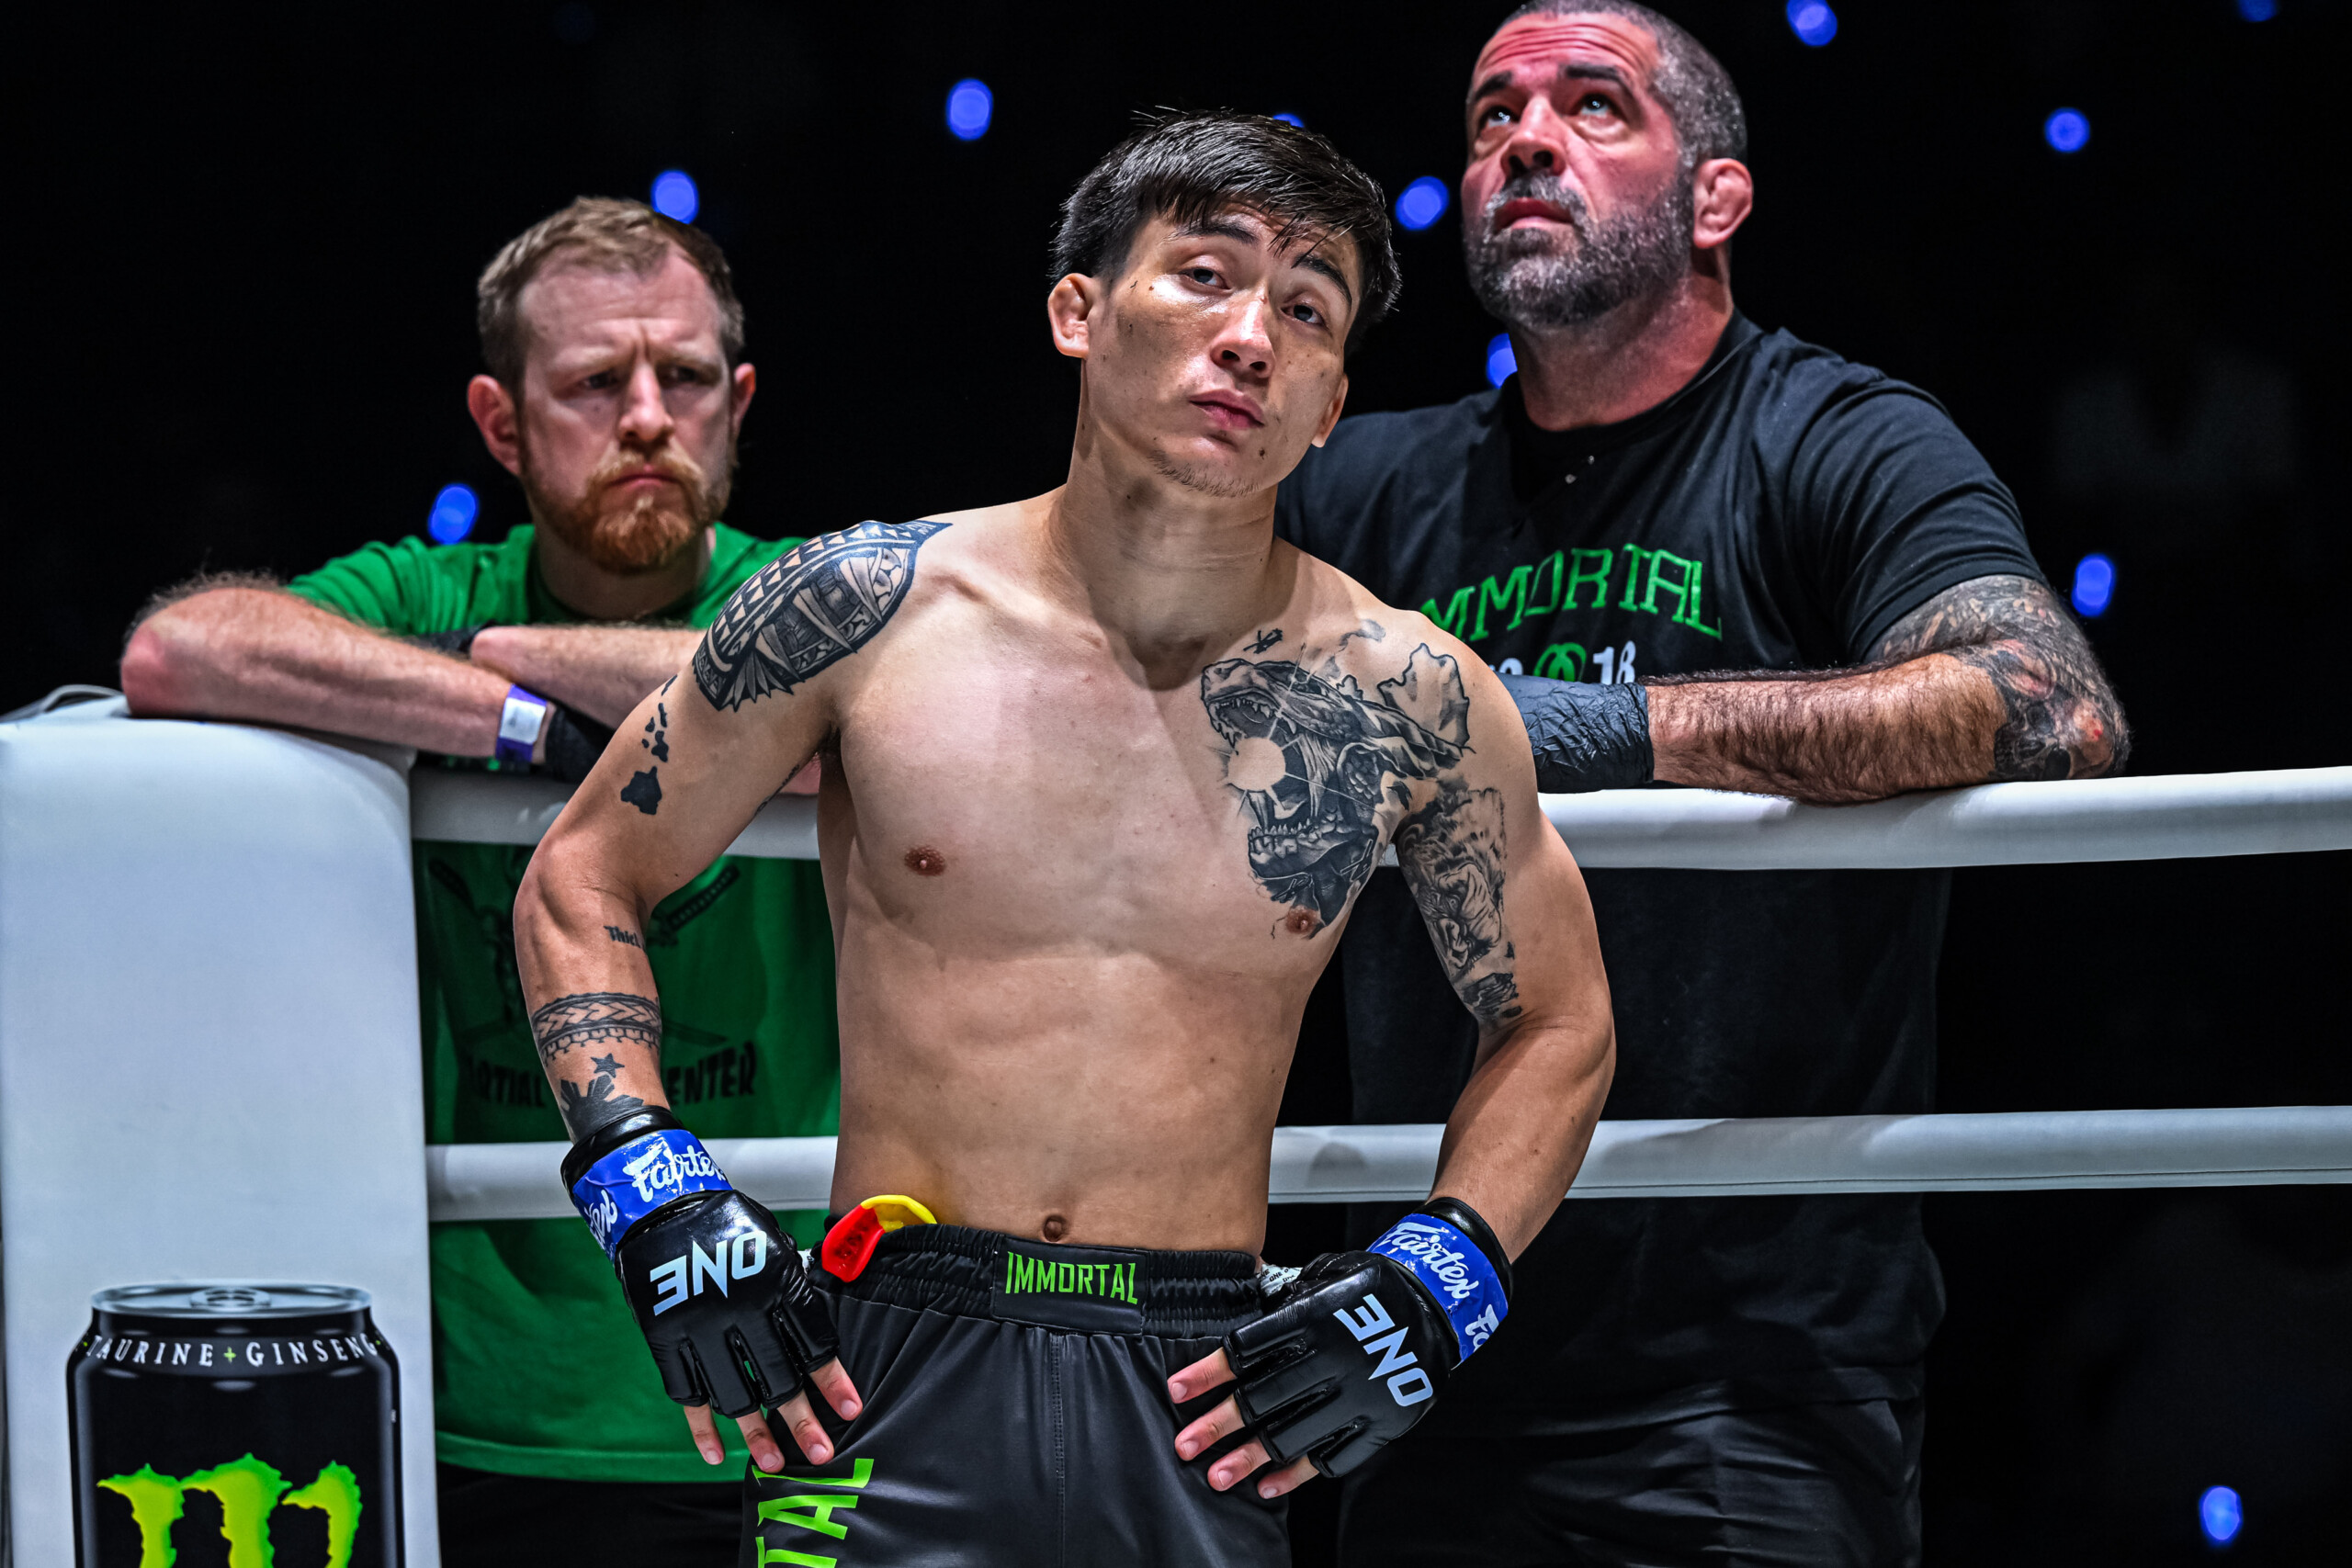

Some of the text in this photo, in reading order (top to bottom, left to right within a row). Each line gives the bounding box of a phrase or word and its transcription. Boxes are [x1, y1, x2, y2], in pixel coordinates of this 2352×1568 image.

[1420, 543, 1723, 642] MMORTAL
[666, 1040, 757, 1106] ENTER
[650, 1230, 767, 1316] ONE
[1006, 1251, 1138, 1305] IMMORTAL
[1378, 1222, 1479, 1299] Fairtex
[86, 1335, 214, 1367] TAURINE
[245, 1333, 379, 1367] GINSENG
[1332, 1293, 1433, 1406] ONE
